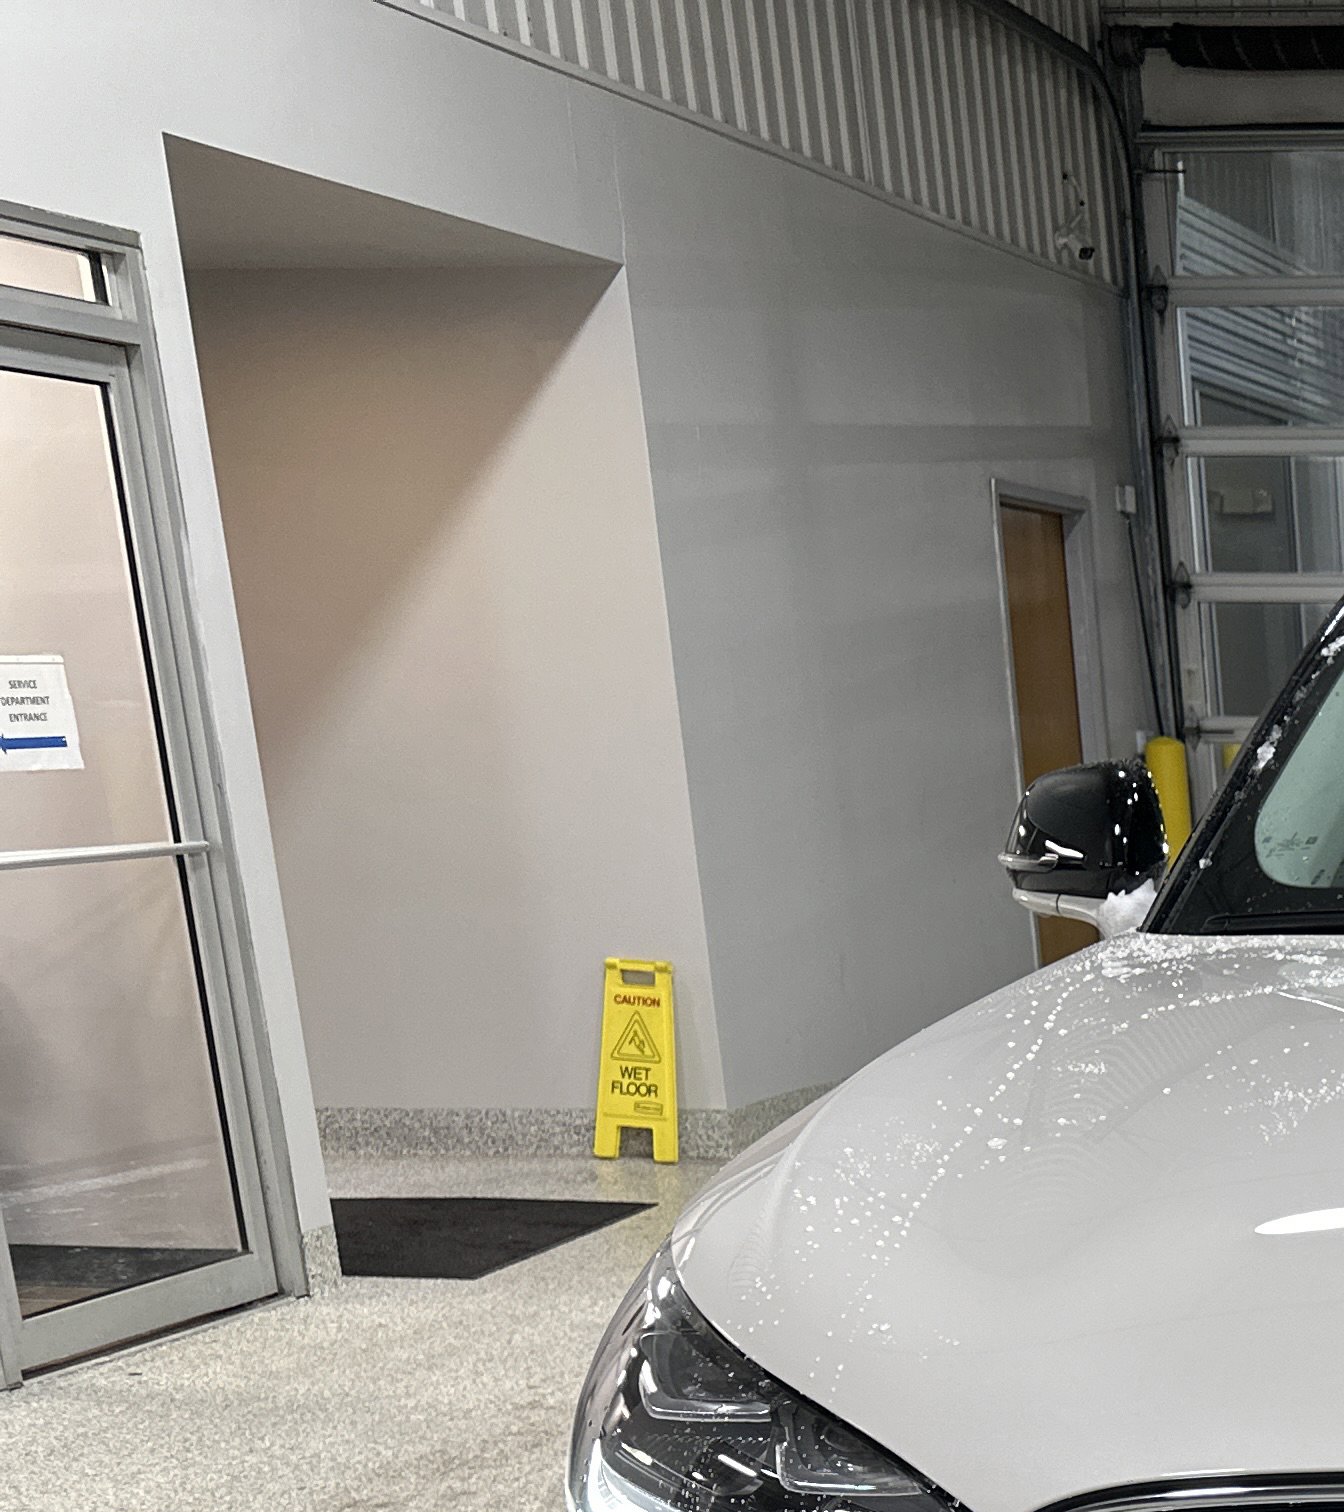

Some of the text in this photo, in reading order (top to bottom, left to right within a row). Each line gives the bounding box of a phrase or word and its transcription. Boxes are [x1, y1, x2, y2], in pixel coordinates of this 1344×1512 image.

[8, 680, 37, 689] SERVICE
[1, 696, 50, 706] DEPARTMENT
[9, 712, 48, 722] ENTRANCE
[613, 994, 661, 1008] CAUTION
[620, 1065, 651, 1081] WET
[611, 1080, 659, 1098] FLOOR
